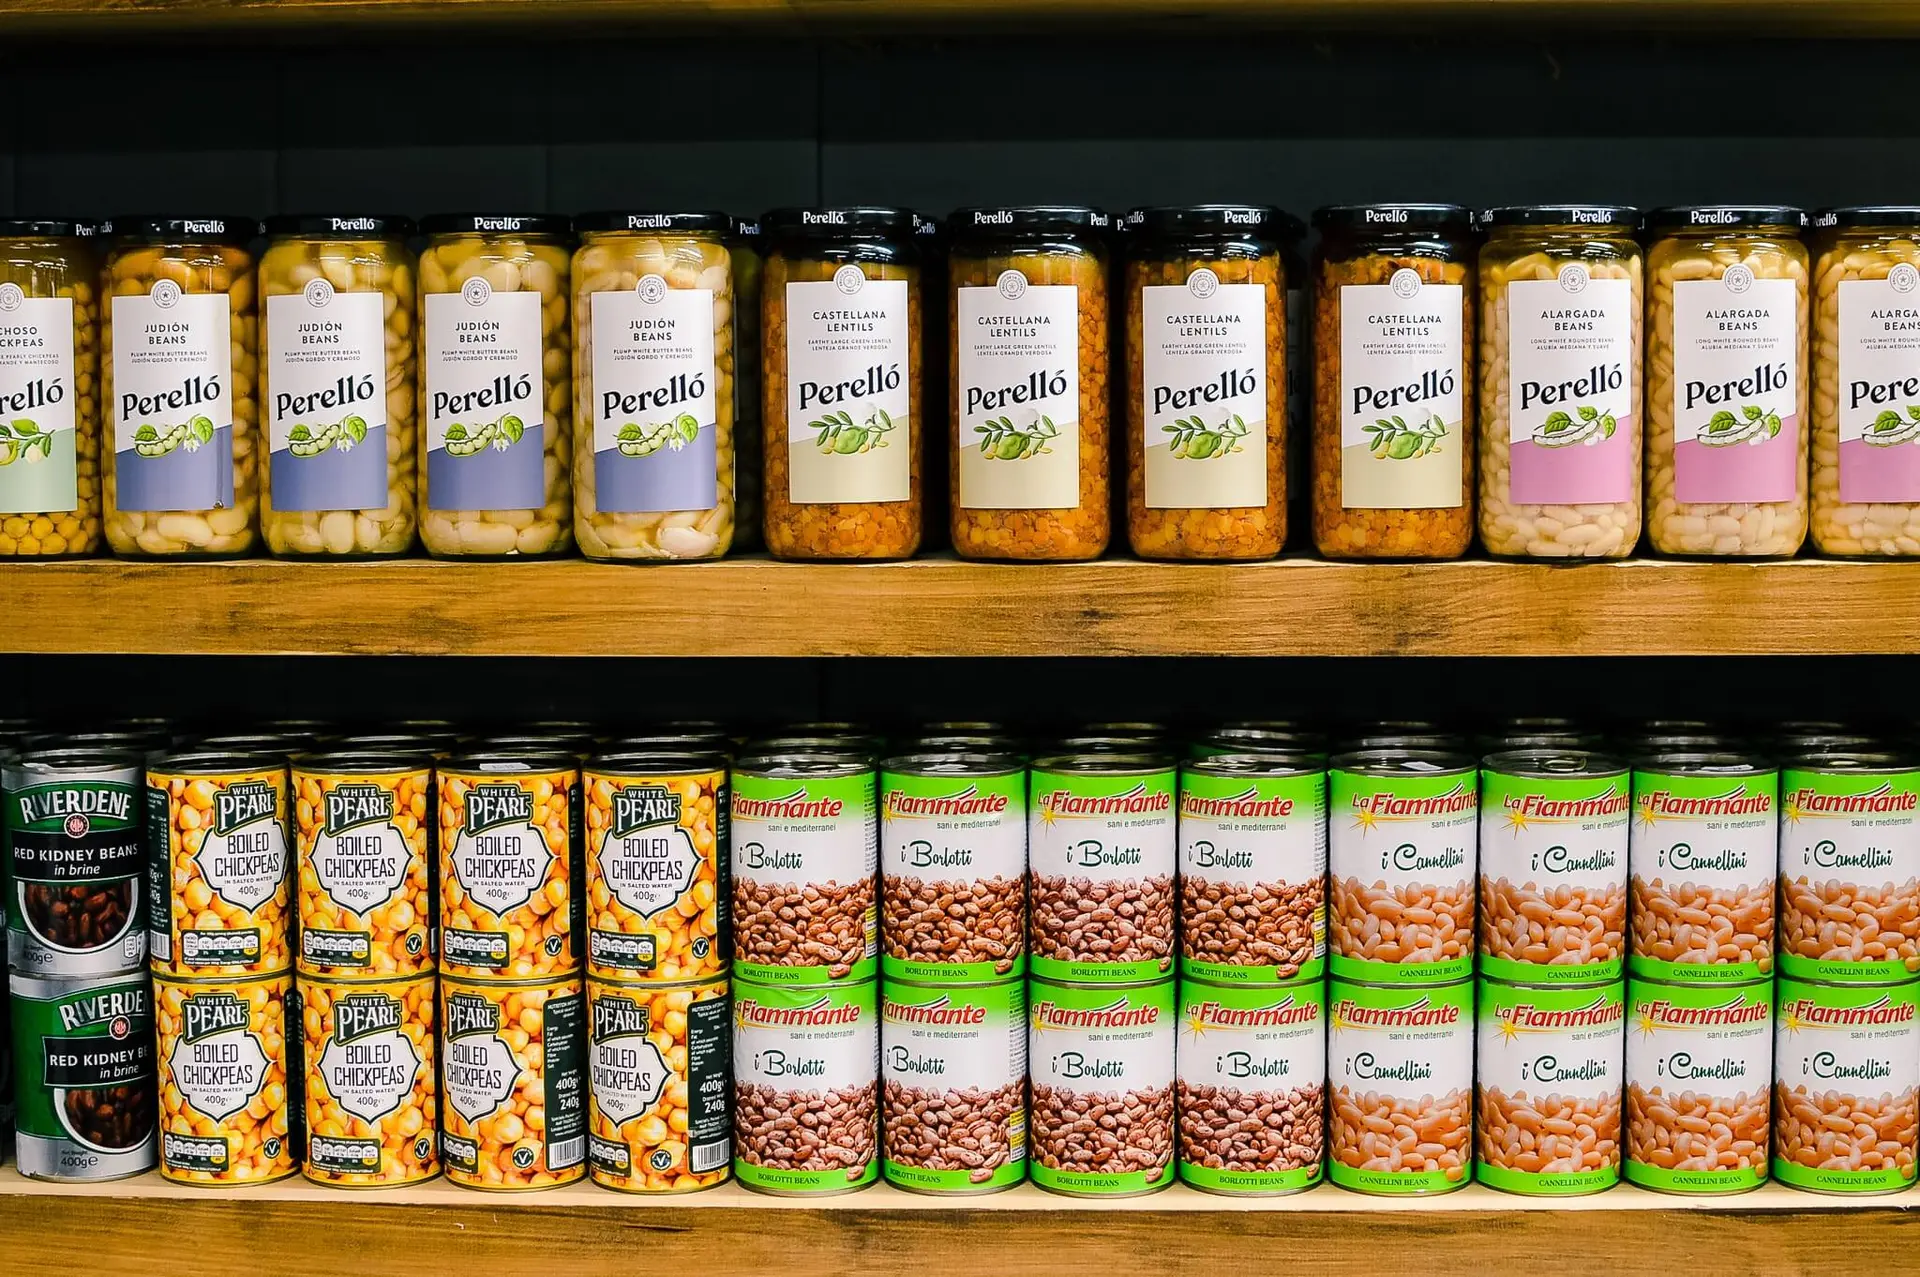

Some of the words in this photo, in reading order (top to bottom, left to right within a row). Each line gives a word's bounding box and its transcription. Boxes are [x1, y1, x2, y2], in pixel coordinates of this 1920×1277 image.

[332, 218, 374, 231] Perelló
[474, 217, 520, 230] Perelló
[628, 215, 671, 228] Perelló
[803, 210, 844, 224] Perelló
[974, 211, 1013, 224] Perelló
[1224, 211, 1261, 224] Perelló
[1366, 210, 1408, 222] Perelló
[1572, 210, 1612, 223] Perelló
[1691, 211, 1732, 224] Perelló
[184, 221, 224, 234] Perelló
[629, 318, 675, 329] JUDIÓN
[812, 310, 887, 320] CASTELLANA
[978, 316, 1050, 325] CASTELLANA
[1167, 315, 1241, 325] CASTELLANA
[1368, 315, 1441, 324] CASTELLANA
[1540, 309, 1605, 320] ALARGADA
[1706, 309, 1770, 320] ALARGADA
[144, 321, 189, 333] JUDIÓN
[298, 321, 342, 332] JUDIÓN
[456, 319, 499, 331] JUDIÓN
[827, 322, 874, 332] LENTILS
[990, 328, 1036, 337] LENTILS
[1180, 327, 1228, 336] LENTILS
[1382, 327, 1429, 336] LENTILS
[1554, 321, 1594, 332] BEANS
[1719, 321, 1758, 332] BEANS
[148, 335, 186, 345] BEANS
[302, 334, 339, 344] BEANS
[459, 333, 496, 343] BEANS
[633, 332, 672, 341] BEANS
[799, 364, 900, 410] Perelló
[967, 369, 1067, 415] Perelló
[1154, 368, 1256, 414] Perelló
[1352, 368, 1454, 414] Perelló
[1520, 362, 1622, 409] Perelló
[1685, 362, 1787, 409] Perelló
[122, 374, 221, 421] Perelló
[277, 373, 374, 421] Perelló
[433, 373, 531, 420] Perelló
[603, 372, 705, 420] Perelló
[232, 785, 265, 795] WHITE
[340, 788, 377, 797] WHITE
[481, 788, 517, 797] WHITE
[628, 790, 663, 798] WHITE
[19, 789, 132, 824] RIVERDENE
[219, 794, 274, 830] PEARL
[330, 796, 390, 832] PEARL
[469, 796, 530, 831] PEARL
[617, 798, 678, 832] PEARL
[936, 821, 952, 830] sani
[961, 819, 1000, 830] mediterranei
[14, 846, 35, 859] RED
[39, 849, 95, 862] KIDNEY
[100, 844, 138, 859] BEANS
[228, 832, 269, 855] BOILED
[336, 836, 382, 856] BOILED
[476, 836, 521, 855] BOILED
[623, 838, 668, 858] BOILED
[746, 842, 803, 870] Borlotti
[910, 840, 972, 868] Borlotti
[1078, 840, 1142, 868] Borlotti
[1196, 840, 1253, 869] Borlotti
[1394, 843, 1464, 872] Cannellini
[1543, 844, 1616, 874] Cannellini
[1668, 842, 1748, 872] Cannellini
[1813, 840, 1893, 869] Cannellini
[54, 865, 66, 876] in
[69, 863, 100, 876] brine
[215, 853, 279, 877] CHICKPEAS
[324, 857, 396, 879] CHICKPEAS
[465, 857, 535, 879] CHICKPEAS
[612, 860, 682, 880] CHICKPEAS
[1672, 969, 1718, 979] CANNELLINI
[1720, 969, 1744, 978] BEANS
[197, 998, 233, 1006] WHITE
[350, 998, 387, 1007] WHITE
[454, 996, 482, 1007] WHITE
[602, 999, 632, 1010] WHITE
[186, 1004, 246, 1040] PEARL
[338, 1005, 398, 1043] PEARL
[448, 1005, 496, 1038] PEARL
[594, 1008, 645, 1040] PEARL
[50, 1055, 77, 1067] RED
[83, 1050, 134, 1066] KIDNEY
[194, 1043, 239, 1063] BOILED
[345, 1044, 391, 1065] BOILED
[452, 1043, 488, 1065] BOILED
[600, 1046, 636, 1068] BOILED
[763, 1050, 825, 1076] Borlotti
[892, 1045, 945, 1075] Borlotti
[100, 1068, 110, 1079] in
[113, 1063, 139, 1077] brine
[1061, 1052, 1124, 1079] Borlotti
[1227, 1051, 1289, 1078] Borlotti
[1354, 1052, 1432, 1081] Cannellini
[1534, 1054, 1607, 1083] Cannellini
[1668, 1051, 1746, 1081] Cannellini
[1812, 1050, 1891, 1080] Cannellini
[183, 1064, 253, 1086] CHICKPEAS
[334, 1065, 404, 1087] CHICKPEAS
[447, 1065, 502, 1090] CHICKPEAS
[594, 1070, 650, 1092] CHICKPEAS
[758, 1172, 790, 1184] BORLOTTI
[792, 1174, 820, 1184] BEANS
[1359, 1177, 1402, 1186] CANNELLINI
[1403, 1178, 1429, 1186] BEANS
